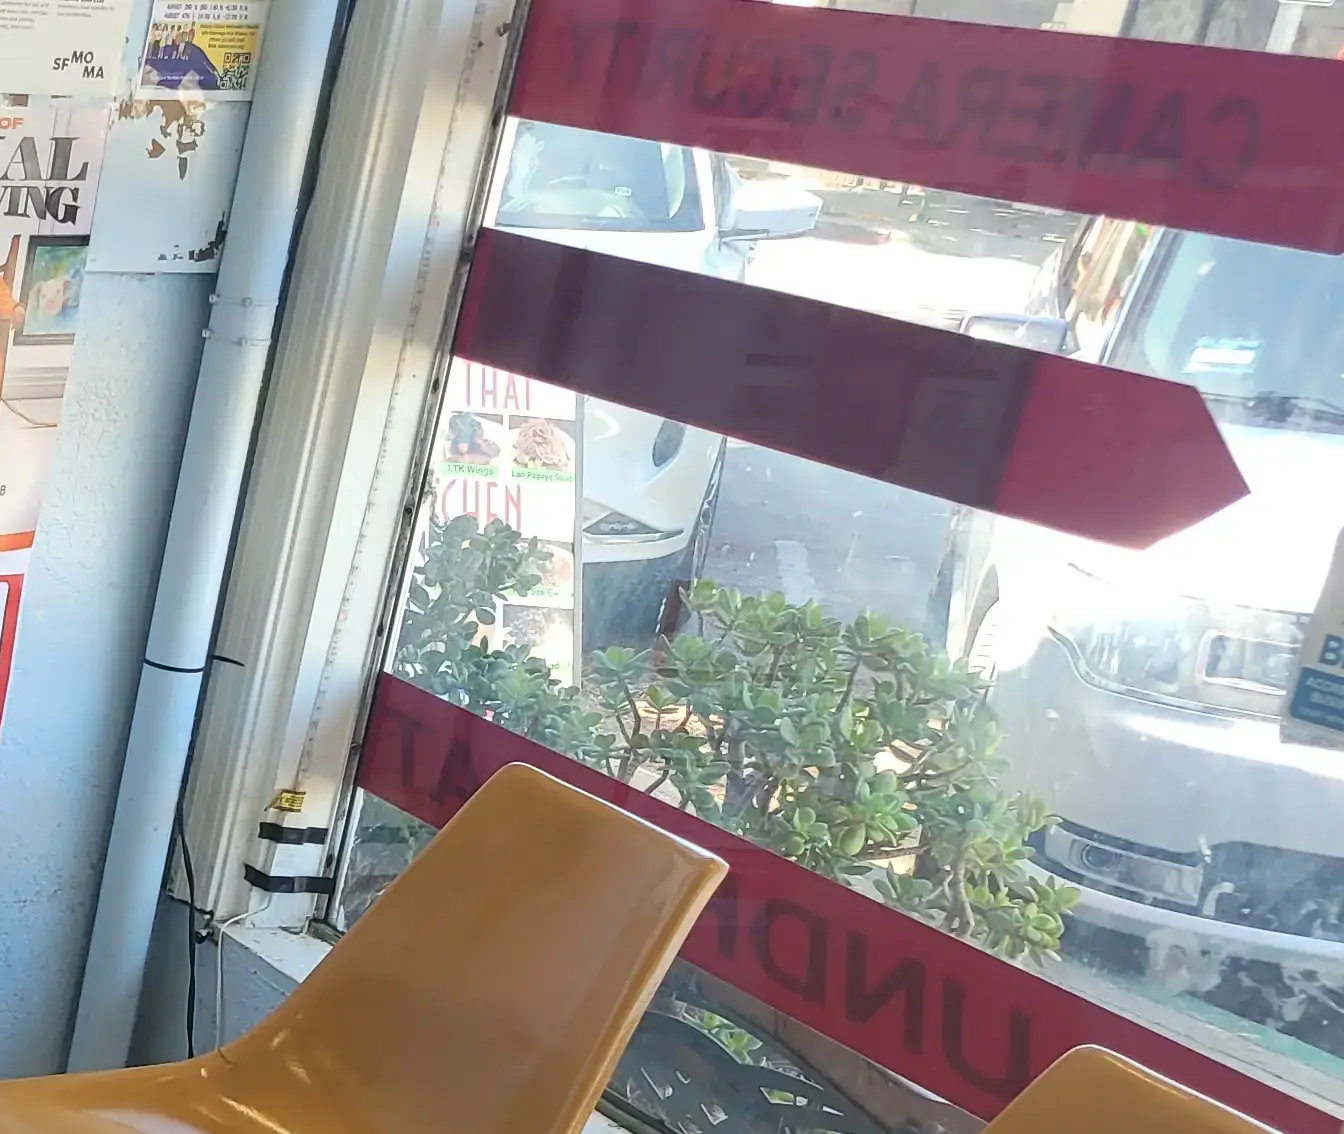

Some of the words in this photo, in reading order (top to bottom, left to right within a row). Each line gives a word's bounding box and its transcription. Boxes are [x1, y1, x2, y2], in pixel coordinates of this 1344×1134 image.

[53, 57, 69, 71] SF
[71, 51, 94, 64] MO
[82, 65, 105, 80] MA
[0, 485, 6, 497] 8
